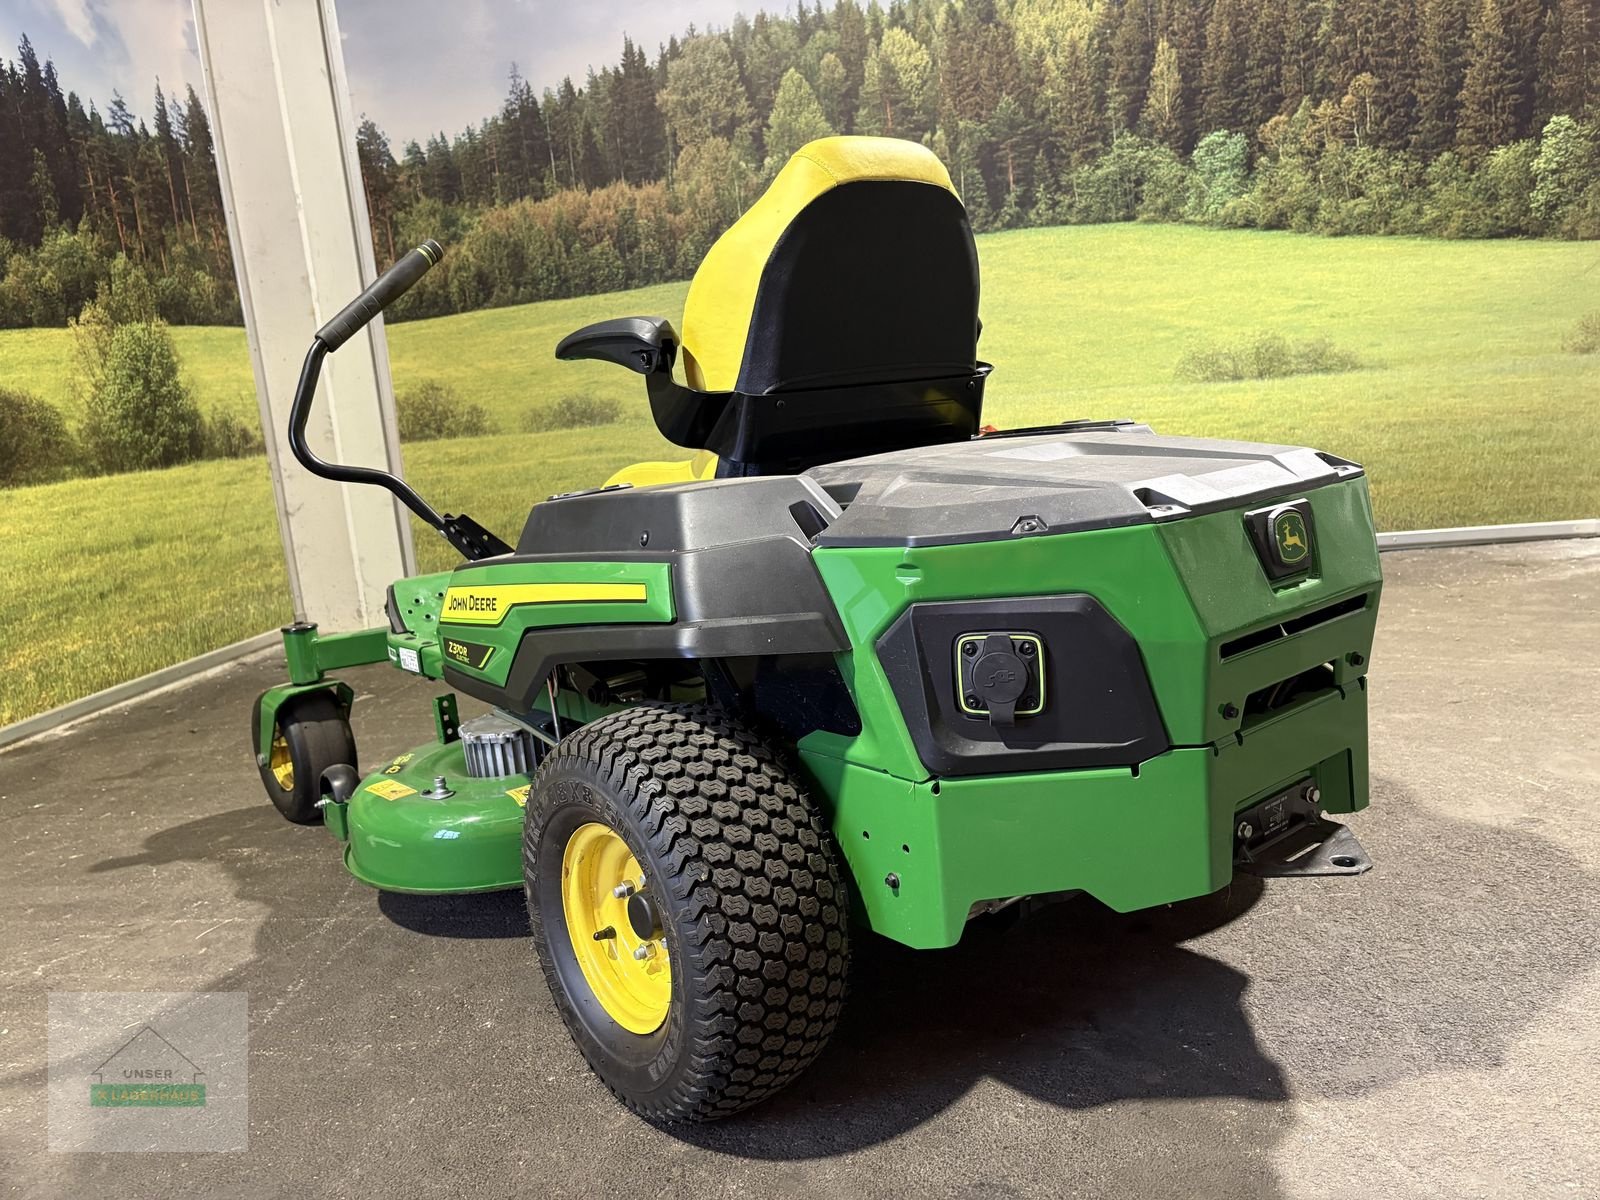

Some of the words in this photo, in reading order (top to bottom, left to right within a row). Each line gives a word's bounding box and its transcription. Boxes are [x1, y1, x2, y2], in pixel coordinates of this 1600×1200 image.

[449, 595, 467, 611] JOHN
[469, 595, 497, 611] DEERE
[448, 641, 468, 657] Z370R
